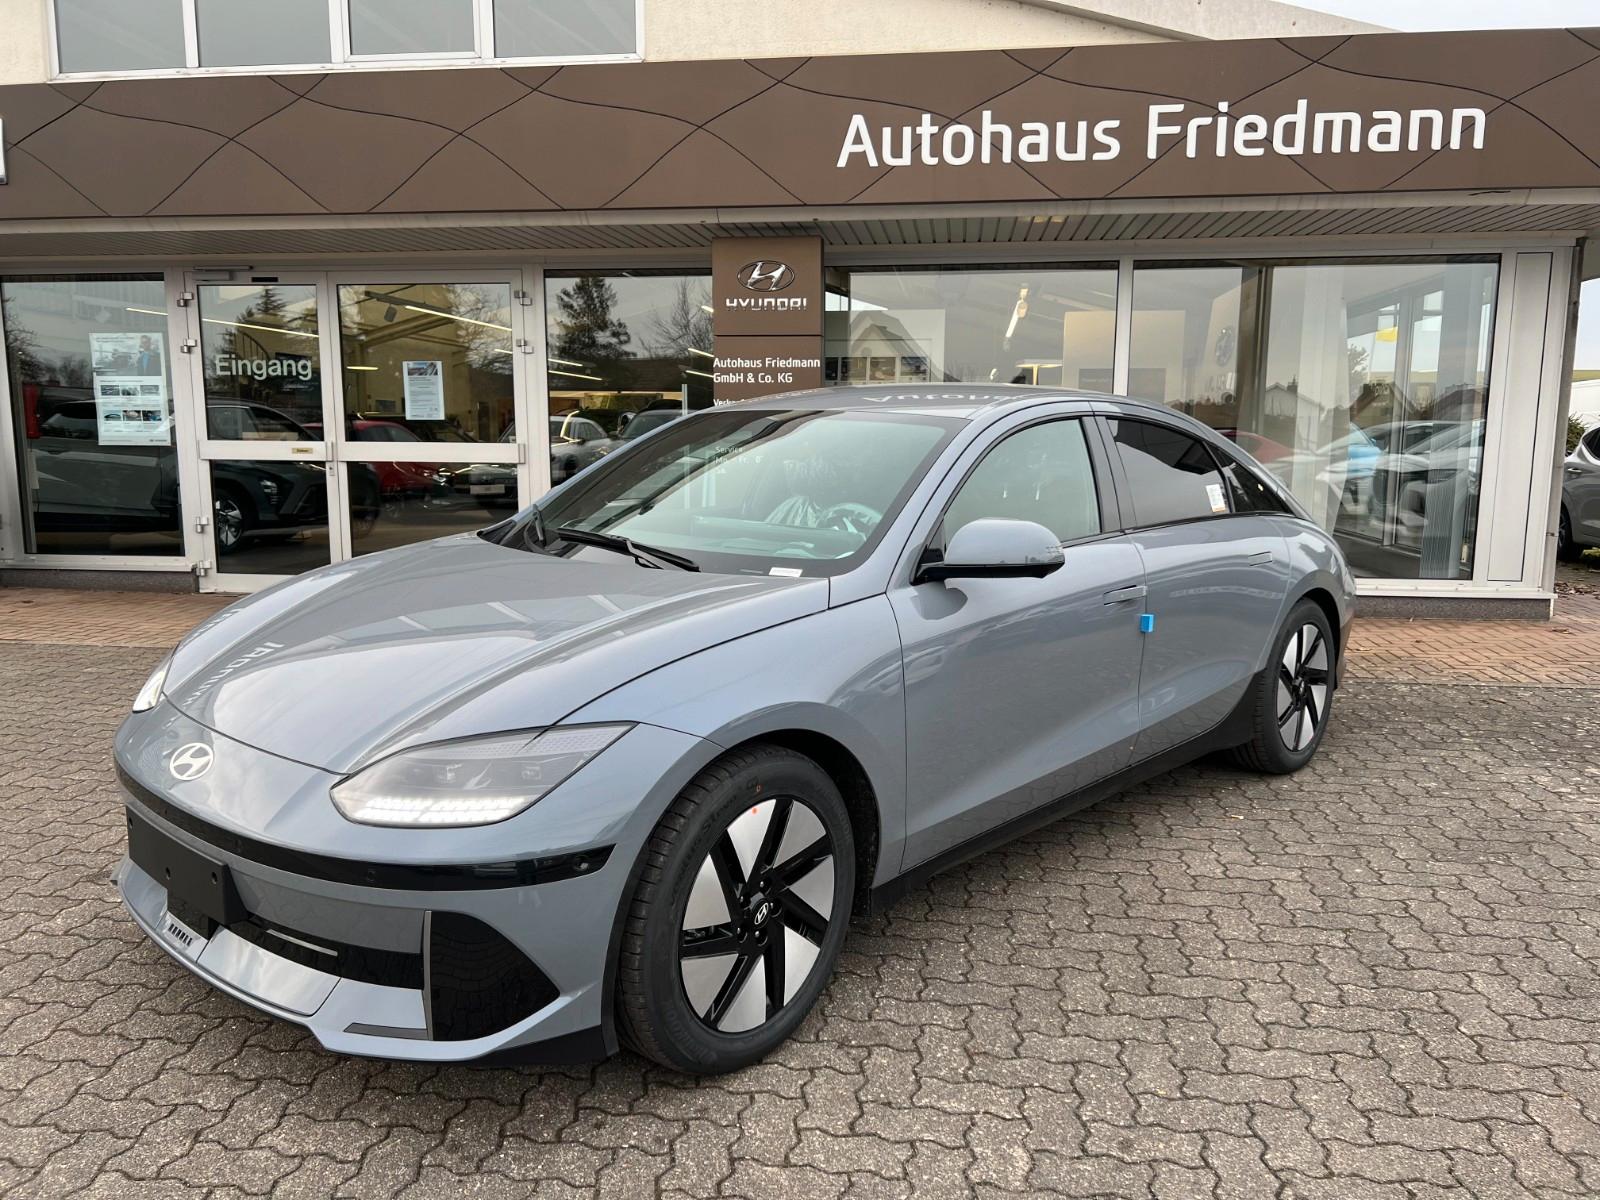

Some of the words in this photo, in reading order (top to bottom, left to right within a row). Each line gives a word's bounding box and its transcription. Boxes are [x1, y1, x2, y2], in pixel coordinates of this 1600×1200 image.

[836, 110, 1121, 168] Autohaus
[1146, 99, 1487, 160] Friedmann
[214, 353, 313, 381] Eingang
[713, 357, 763, 368] Autohaus
[765, 357, 821, 368] Friedmann
[713, 372, 744, 383] GmbH
[746, 372, 755, 383] &
[758, 372, 775, 383] Co.
[777, 372, 793, 383] KG
